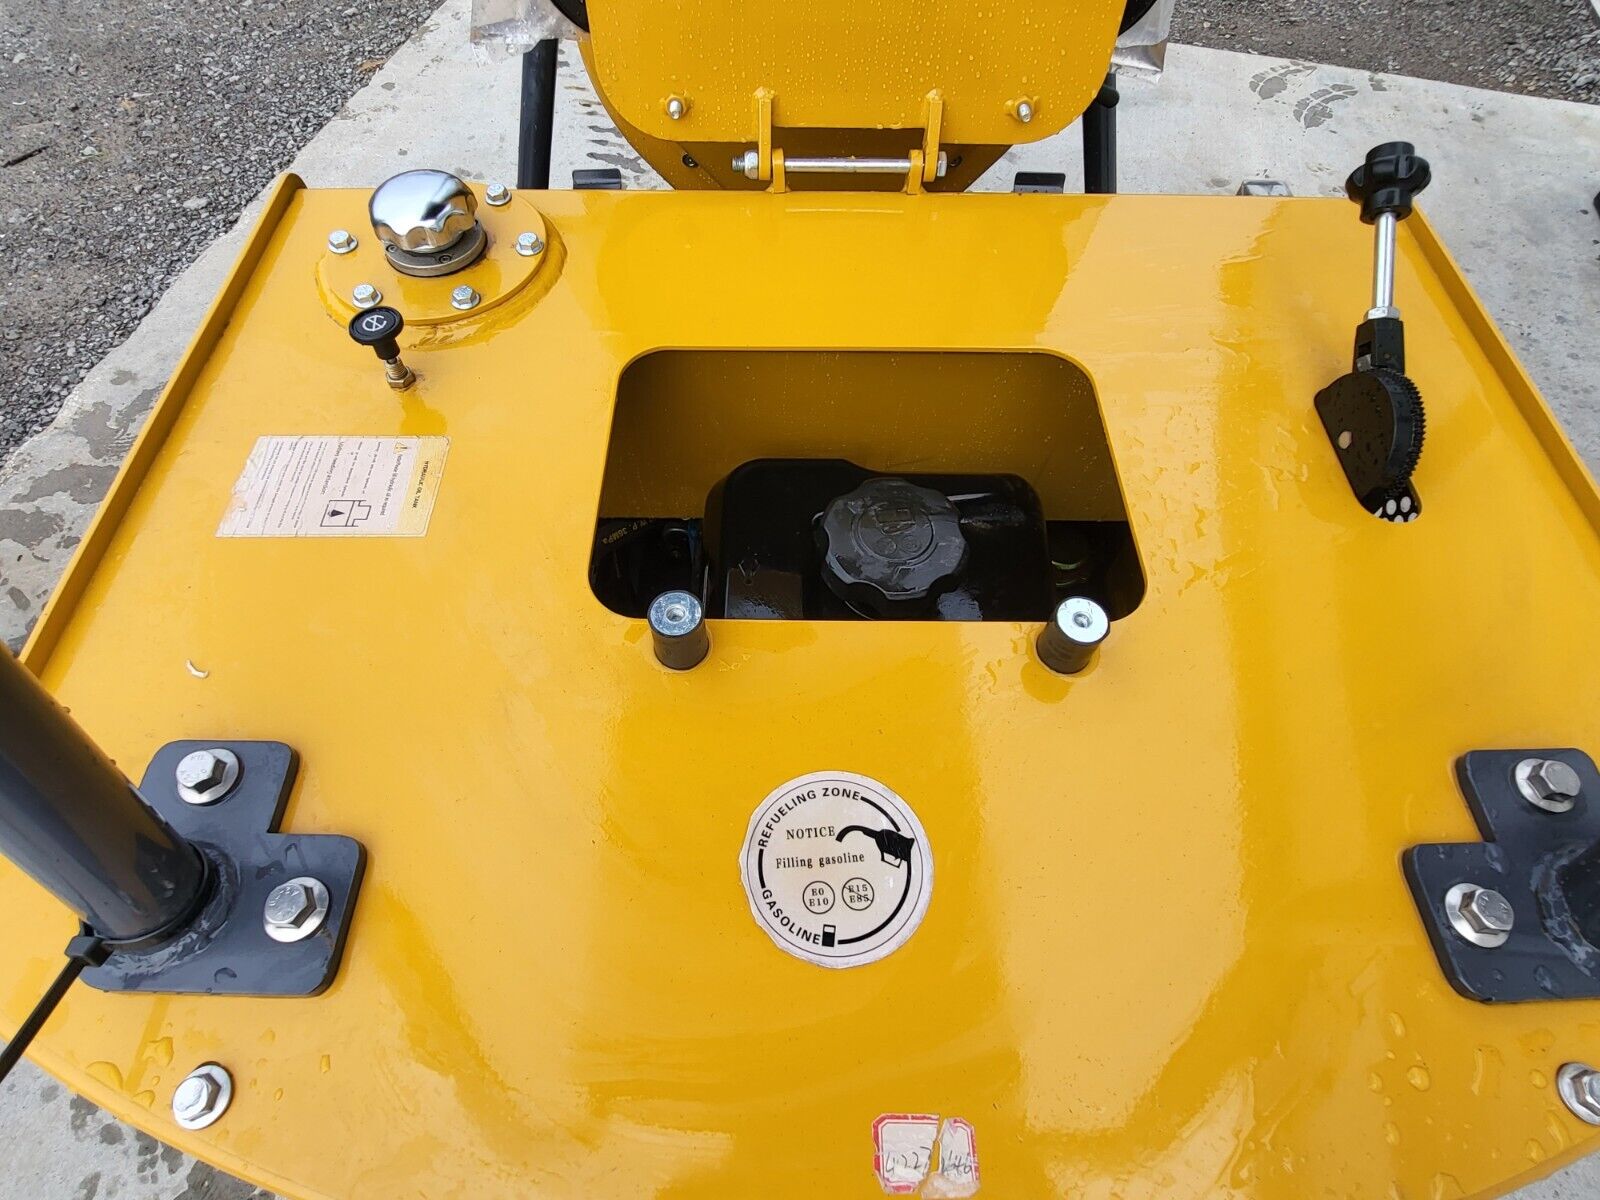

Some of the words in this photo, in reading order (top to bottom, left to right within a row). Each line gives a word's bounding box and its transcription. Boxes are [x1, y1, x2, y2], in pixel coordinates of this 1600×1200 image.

[418, 460, 429, 486] HYDRAULIC
[412, 496, 420, 508] TANK
[758, 789, 816, 848] REFUELING
[822, 787, 860, 801] ZONE
[786, 826, 835, 840] NOTICE
[776, 856, 813, 869] Filling
[819, 852, 865, 867] gasoline
[811, 888, 825, 896] E0
[809, 898, 829, 907] E10
[762, 889, 820, 945] GASOLINE
